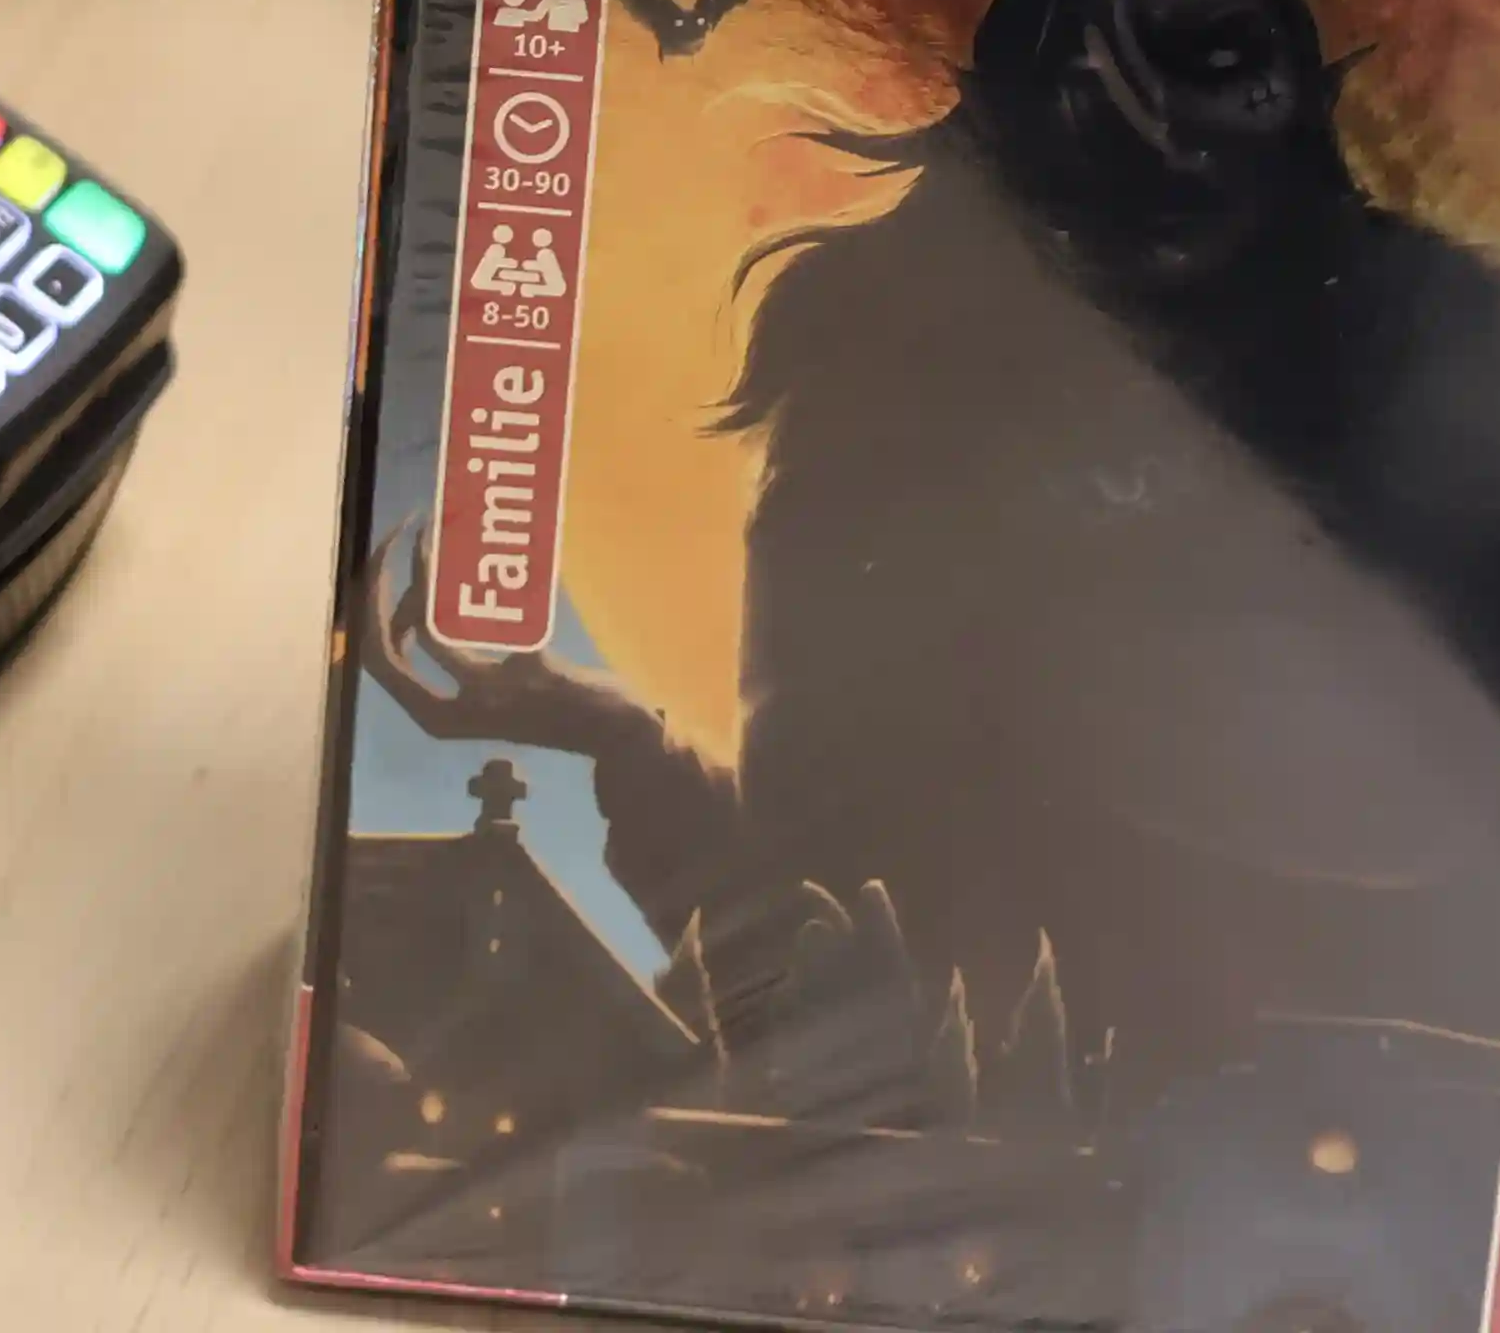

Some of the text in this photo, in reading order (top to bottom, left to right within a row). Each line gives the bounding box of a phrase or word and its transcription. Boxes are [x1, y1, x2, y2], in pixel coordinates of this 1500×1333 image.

[512, 34, 566, 59] 10+
[484, 167, 571, 197] 30-90
[482, 303, 550, 330] 8-50
[458, 364, 545, 622] Familie
